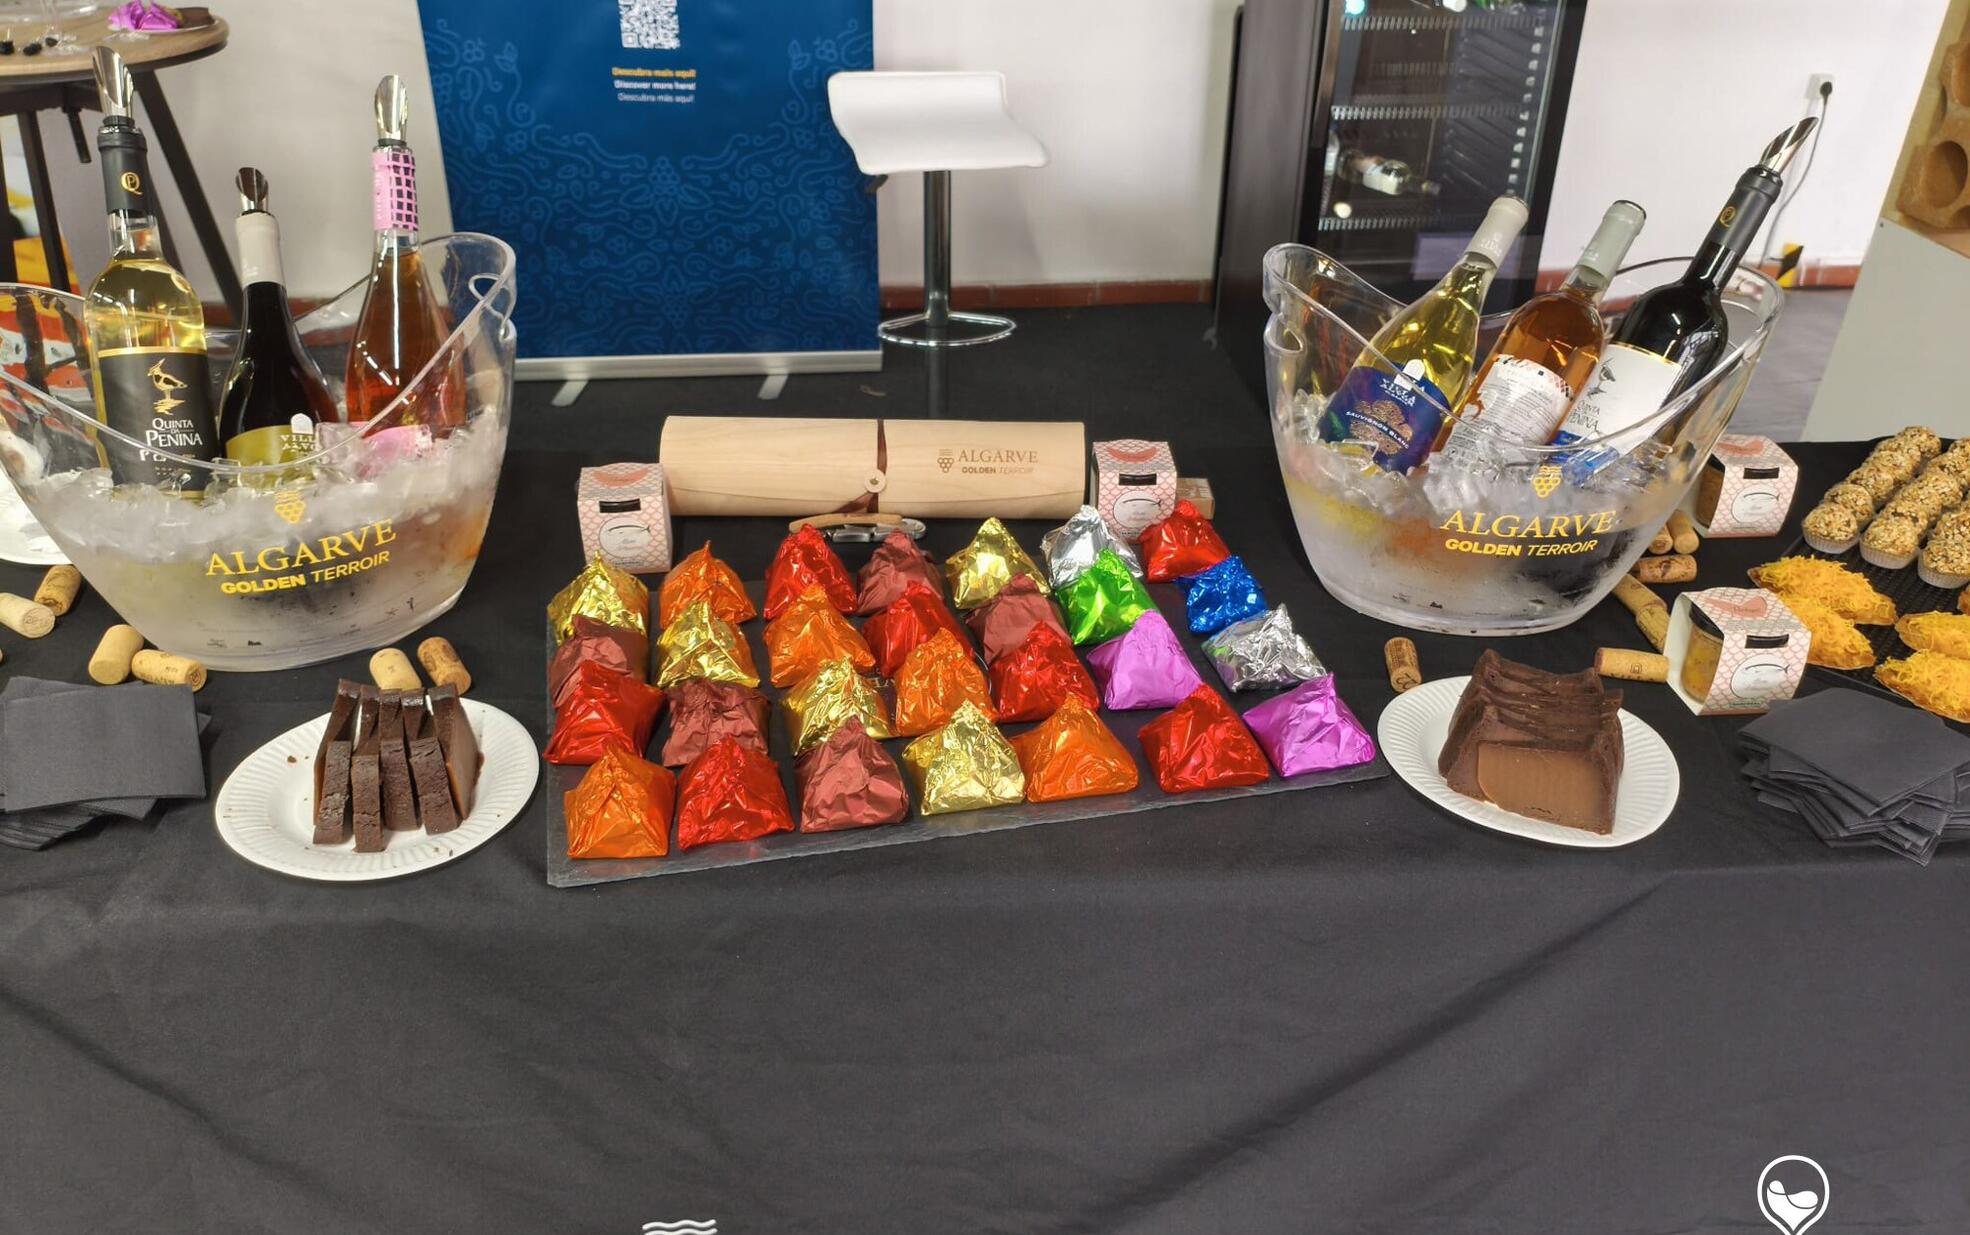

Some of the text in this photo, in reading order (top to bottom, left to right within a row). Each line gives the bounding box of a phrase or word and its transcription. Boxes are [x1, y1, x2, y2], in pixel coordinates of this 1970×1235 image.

[152, 417, 194, 431] QUINTA
[1346, 411, 1410, 450] SAUVIGNON BLANC
[146, 430, 203, 448] PENINA
[280, 434, 316, 443] VILL
[958, 449, 1038, 463] ALGARVE
[961, 466, 997, 474] GOLDEN
[1440, 510, 1617, 538] ALGARVE
[205, 518, 397, 577] ALGARVE
[1445, 538, 1598, 557] GOLDEN TERROIR
[220, 550, 390, 594] GOLDEN TERROIR
